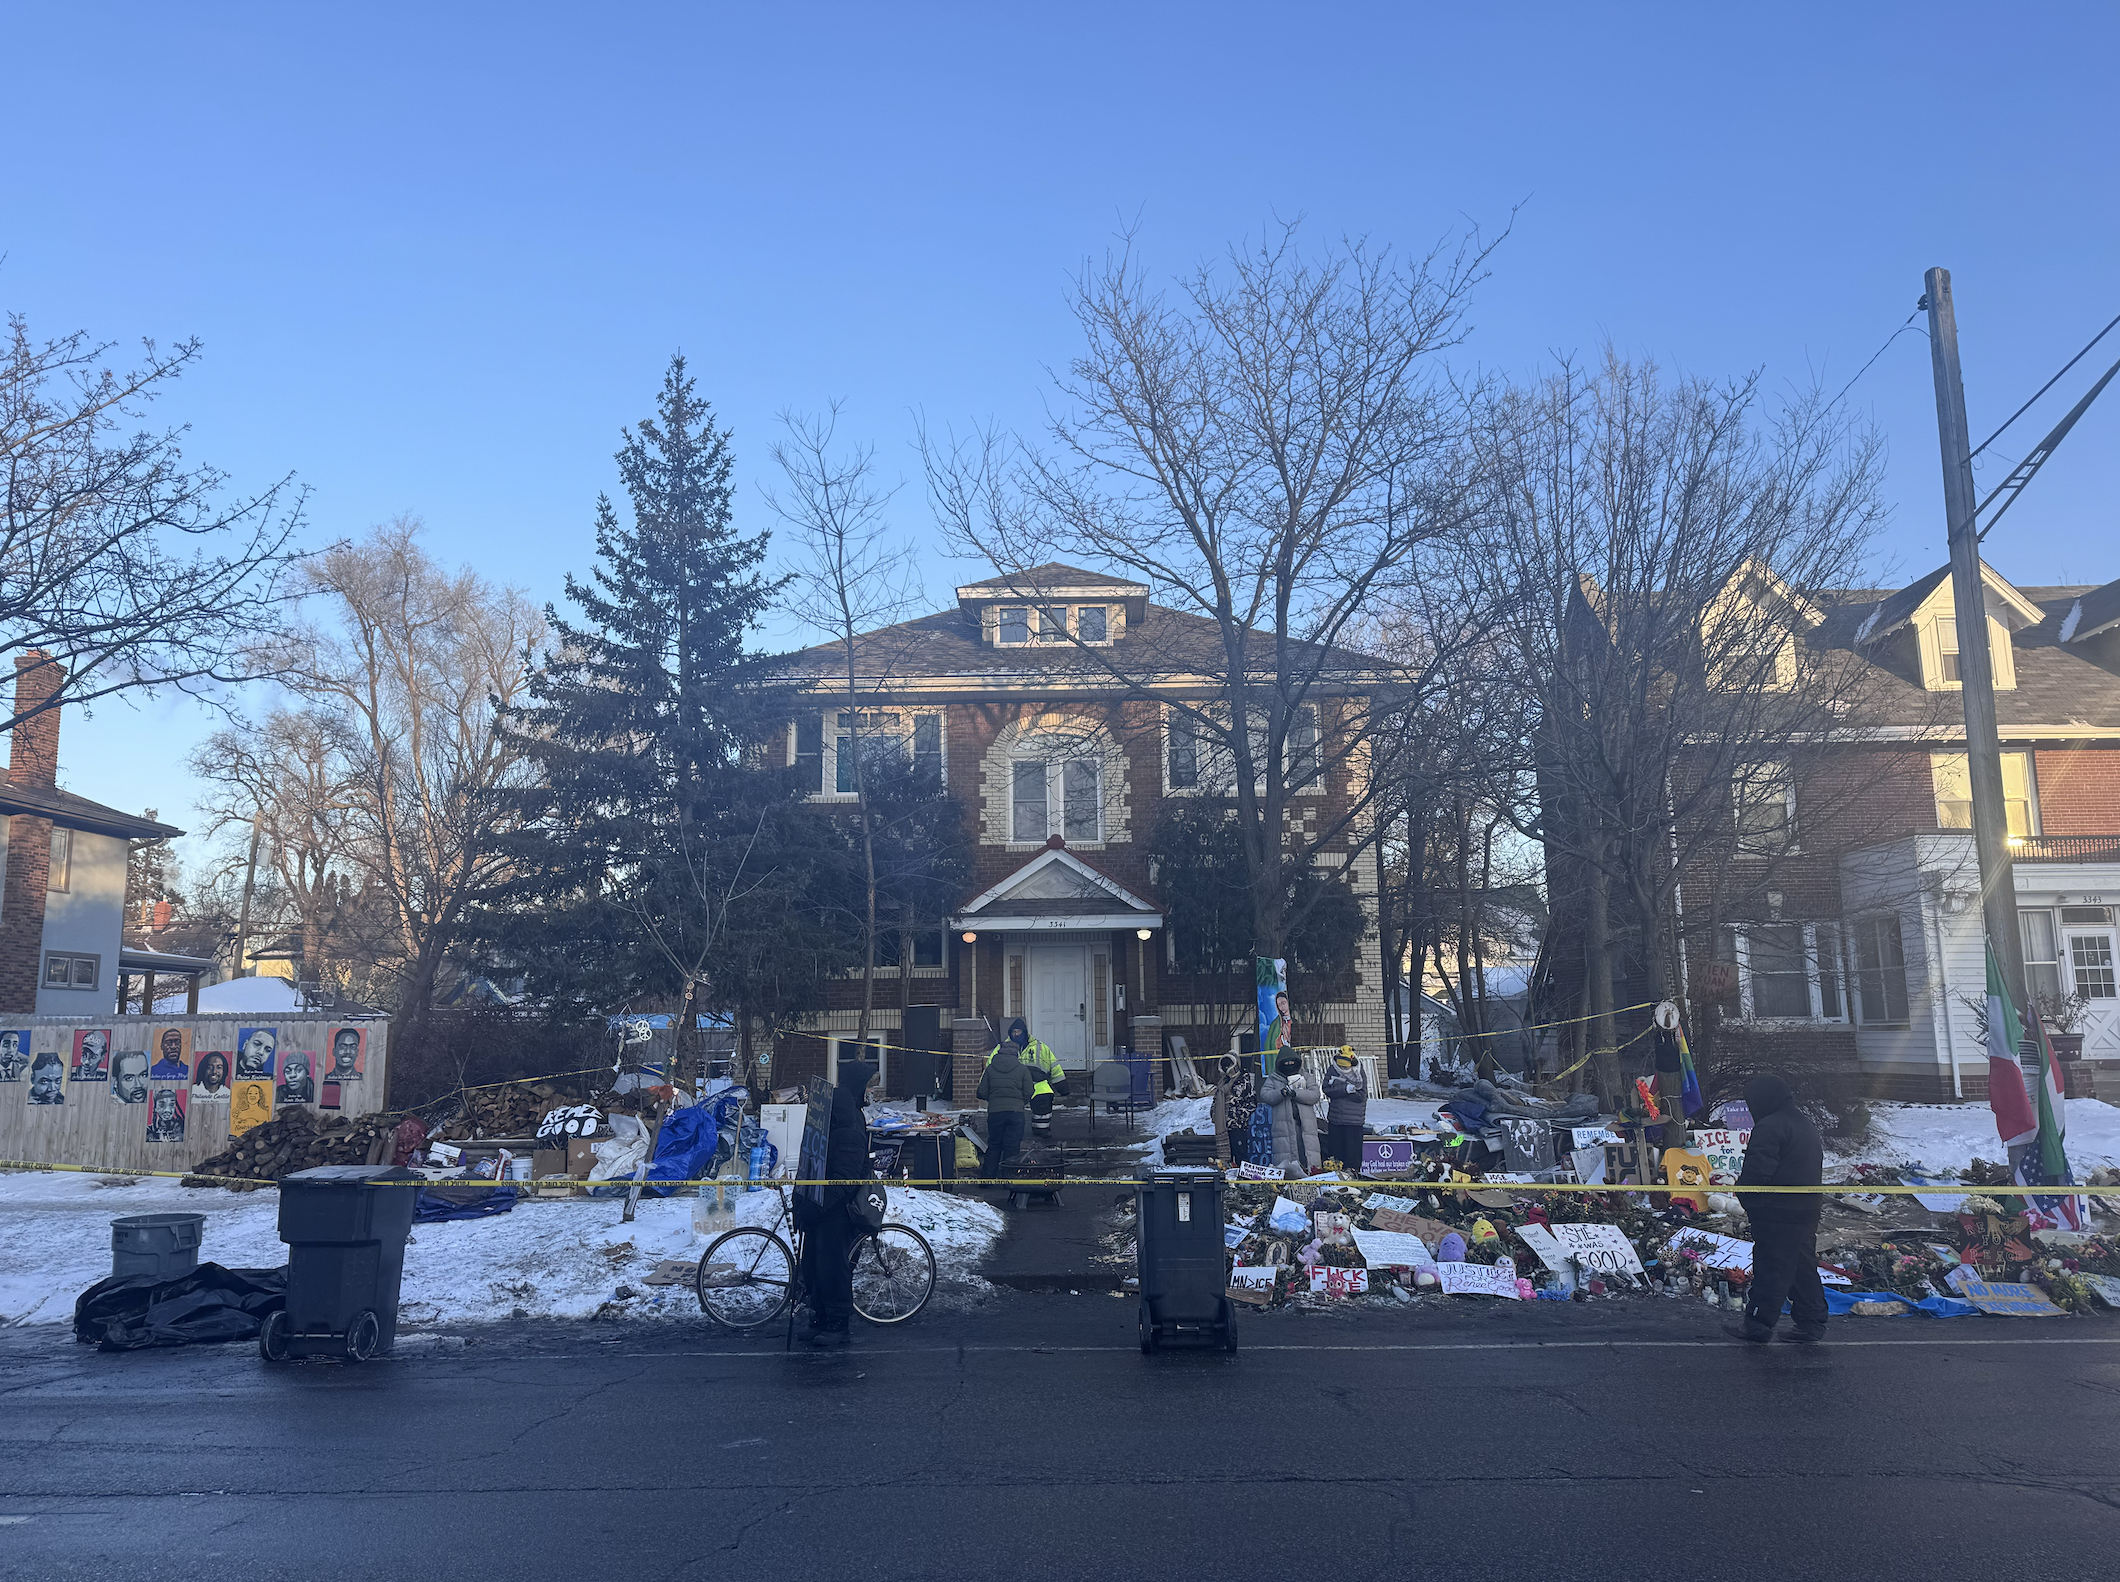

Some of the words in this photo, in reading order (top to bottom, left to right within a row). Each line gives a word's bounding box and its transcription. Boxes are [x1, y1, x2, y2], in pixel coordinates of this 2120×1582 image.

[2082, 895, 2102, 904] 3343
[1698, 963, 1730, 978] TIEN
[1695, 974, 1726, 988] XUAN
[536, 1117, 597, 1138] GOOD
[1576, 1130, 1616, 1139] REMEMBE
[802, 1125, 827, 1161] ICE
[1704, 1131, 1731, 1147] ICE
[1719, 1145, 1734, 1154] for
[1380, 1210, 1418, 1227] SHE
[1566, 1227, 1596, 1243] SHE
[1963, 1221, 2022, 1236] REACH
[1583, 1241, 1604, 1249] WAS
[1982, 1234, 2013, 1246] FOR
[1573, 1250, 1627, 1270] GOOD
[1969, 1248, 2024, 1263] PEACE
[1312, 1265, 1366, 1281] FUCK
[1465, 1274, 1488, 1282] FOR
[1443, 1276, 1488, 1292] Renee
[1488, 1280, 1521, 1295] Good
[1965, 1283, 1990, 1298] NO
[1990, 1284, 2036, 1298] MORE
